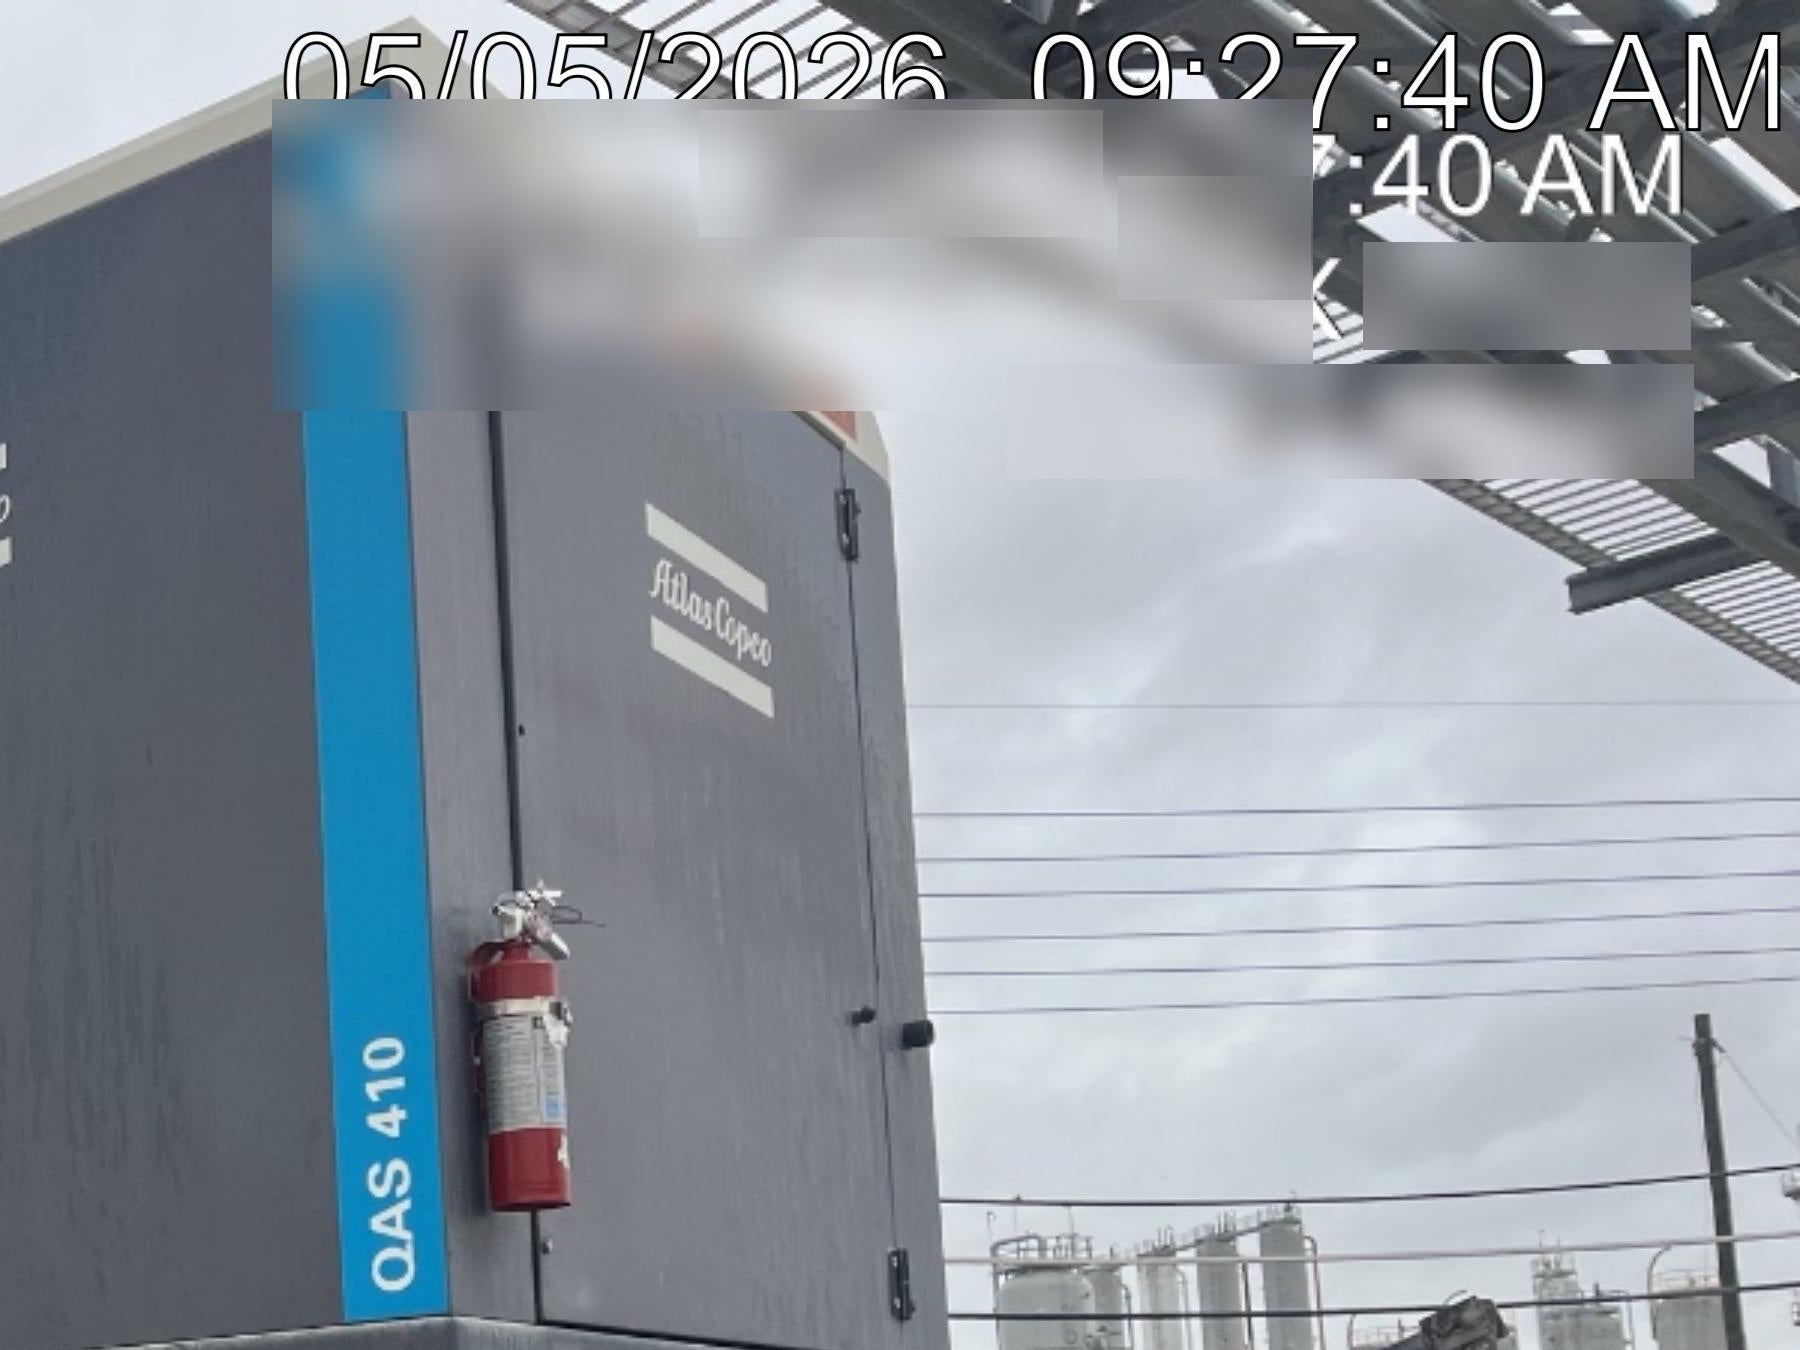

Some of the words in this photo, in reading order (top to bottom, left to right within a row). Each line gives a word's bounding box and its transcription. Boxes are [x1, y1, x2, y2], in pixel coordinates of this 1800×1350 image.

[649, 557, 713, 631] Atlas
[714, 596, 772, 667] Copco
[361, 1035, 408, 1139] 410
[365, 1156, 416, 1292] QAS
